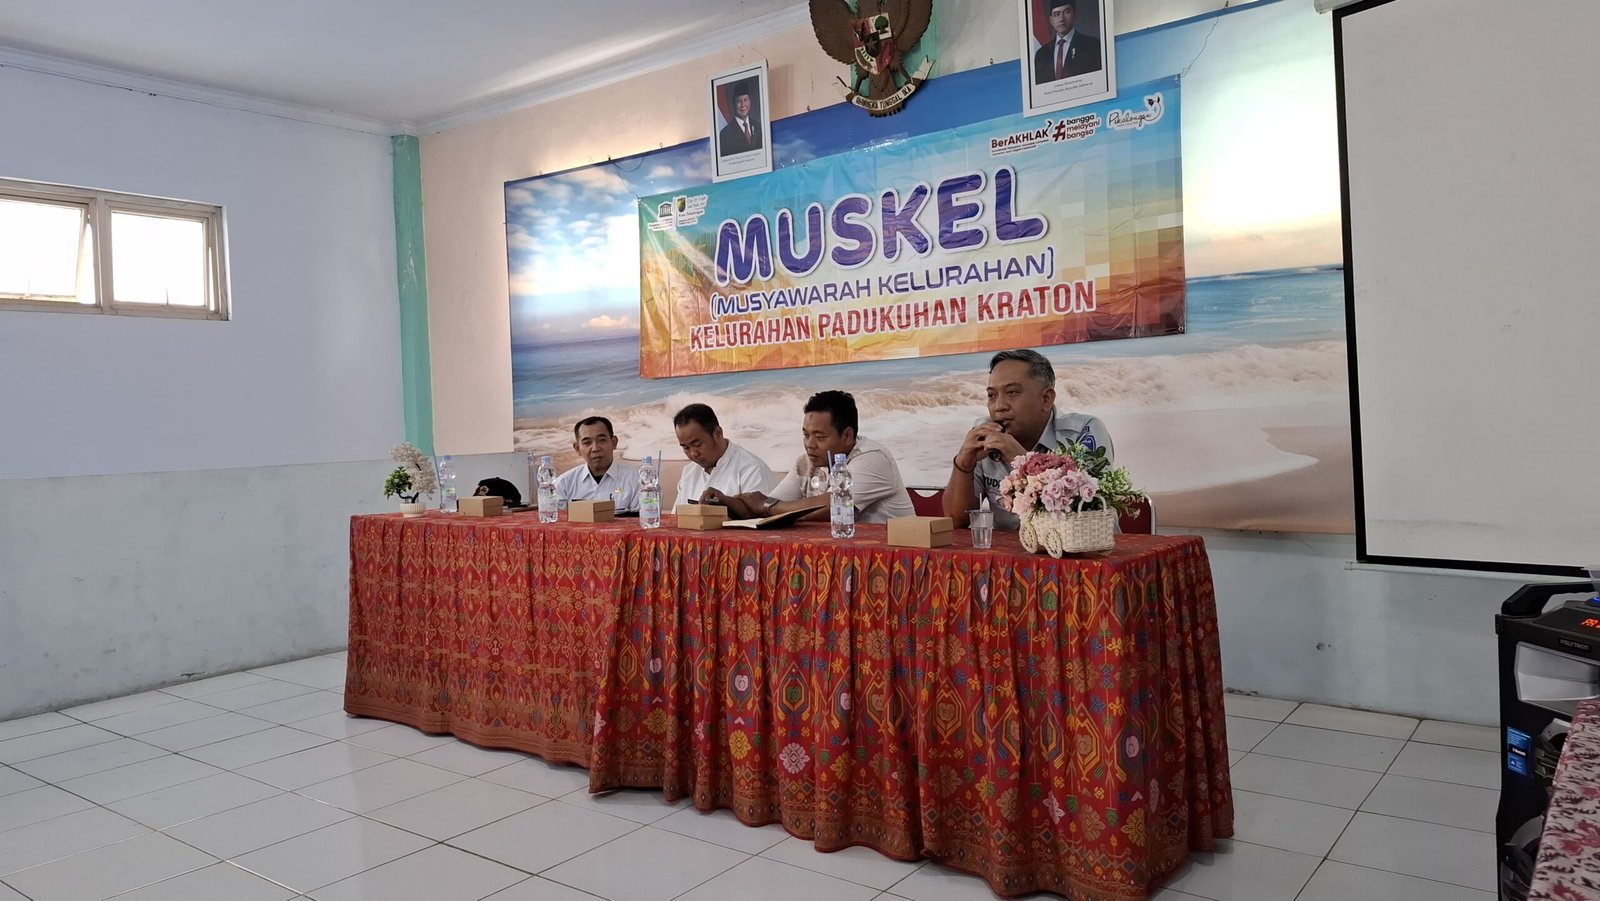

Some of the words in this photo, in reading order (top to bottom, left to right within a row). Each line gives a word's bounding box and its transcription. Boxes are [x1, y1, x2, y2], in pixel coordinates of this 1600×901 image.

[1066, 114, 1095, 126] bangga
[1066, 119, 1101, 133] melayani
[991, 125, 1050, 149] BerAKHLAK
[1066, 129, 1094, 139] bangsa
[715, 166, 1048, 285] MUSKEL
[711, 277, 872, 320] (MUSYAWARAH
[878, 246, 1054, 297] KELURAHAN)
[689, 315, 811, 351] KELURAHAN
[817, 296, 968, 338] PADUKUHAN
[977, 280, 1095, 322] KRATON
